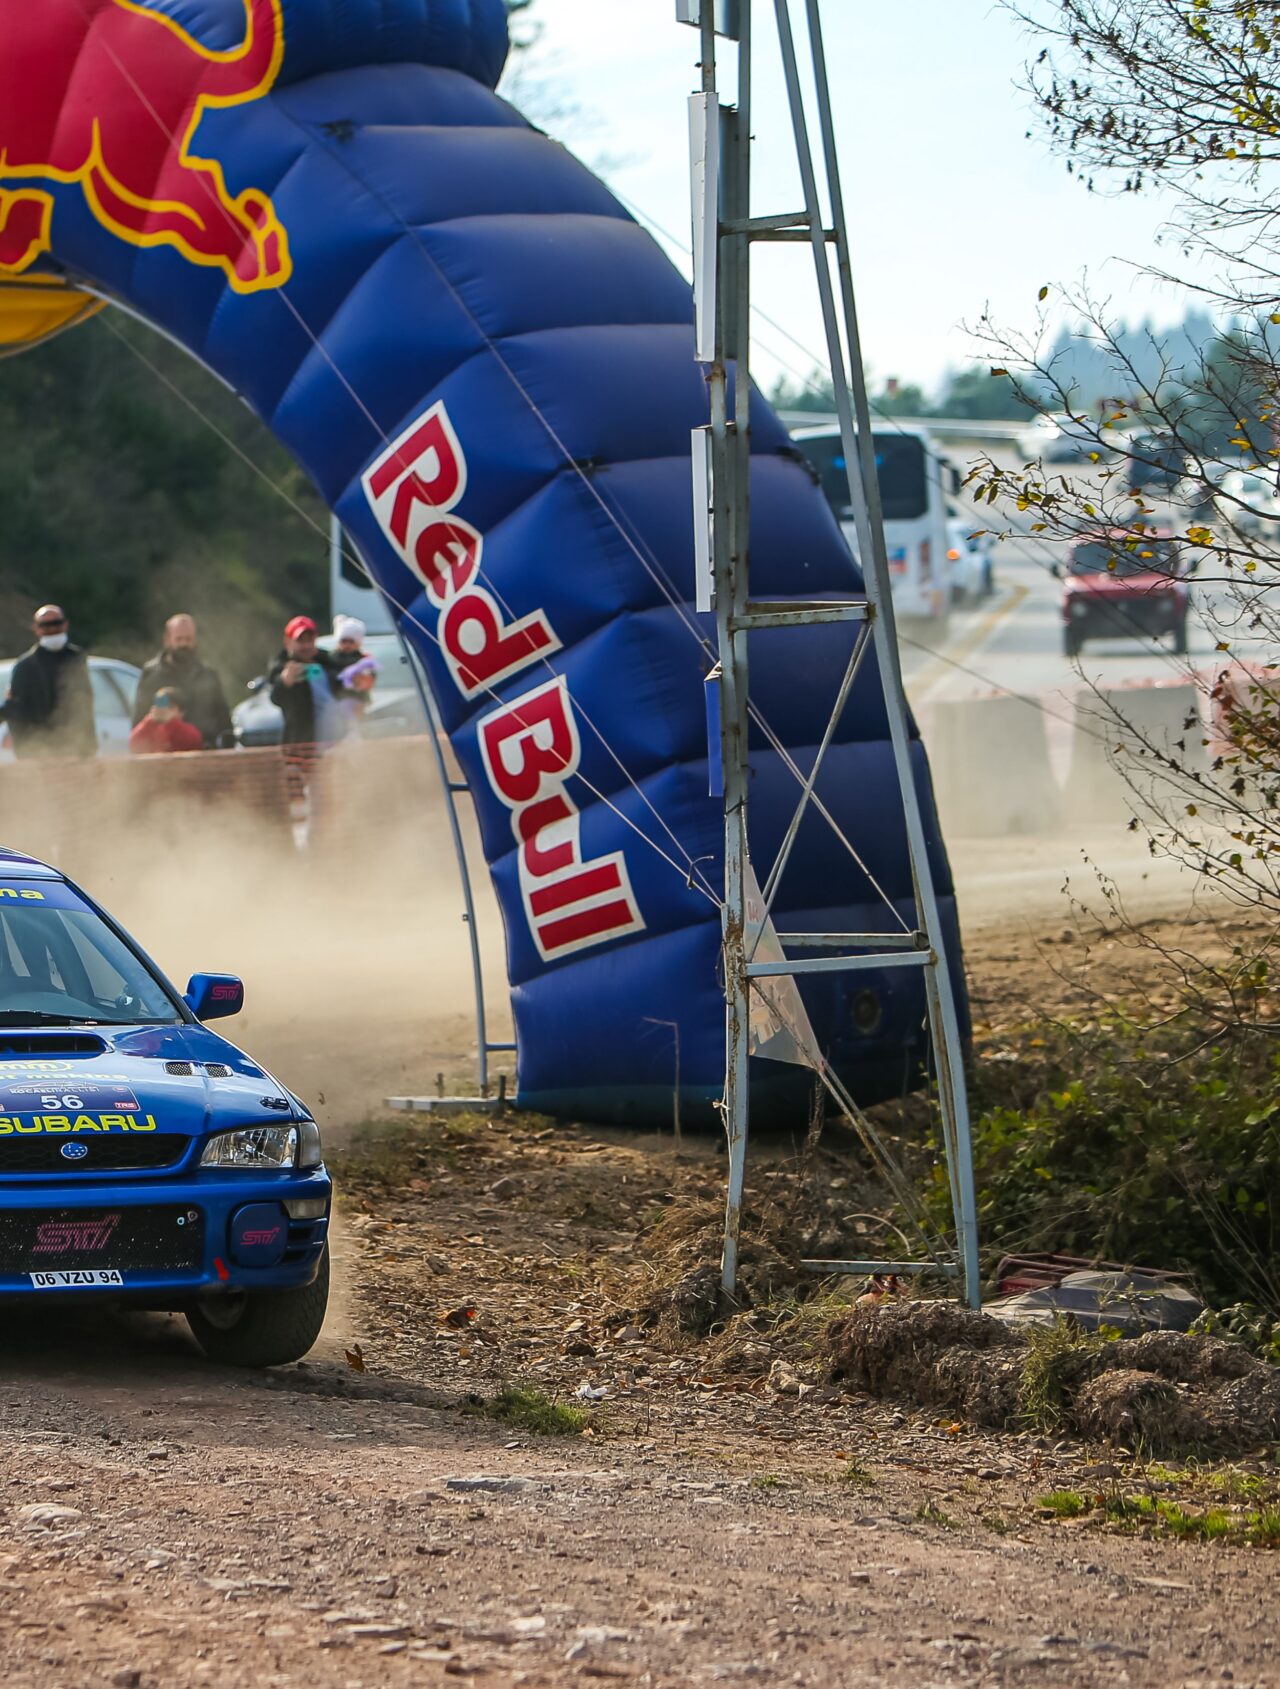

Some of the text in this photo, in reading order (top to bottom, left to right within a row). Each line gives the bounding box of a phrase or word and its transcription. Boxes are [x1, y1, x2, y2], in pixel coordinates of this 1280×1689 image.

[361, 400, 646, 962] Red Bull
[41, 1095, 84, 1110] 56
[34, 1271, 120, 1286] 06 VZU 94
